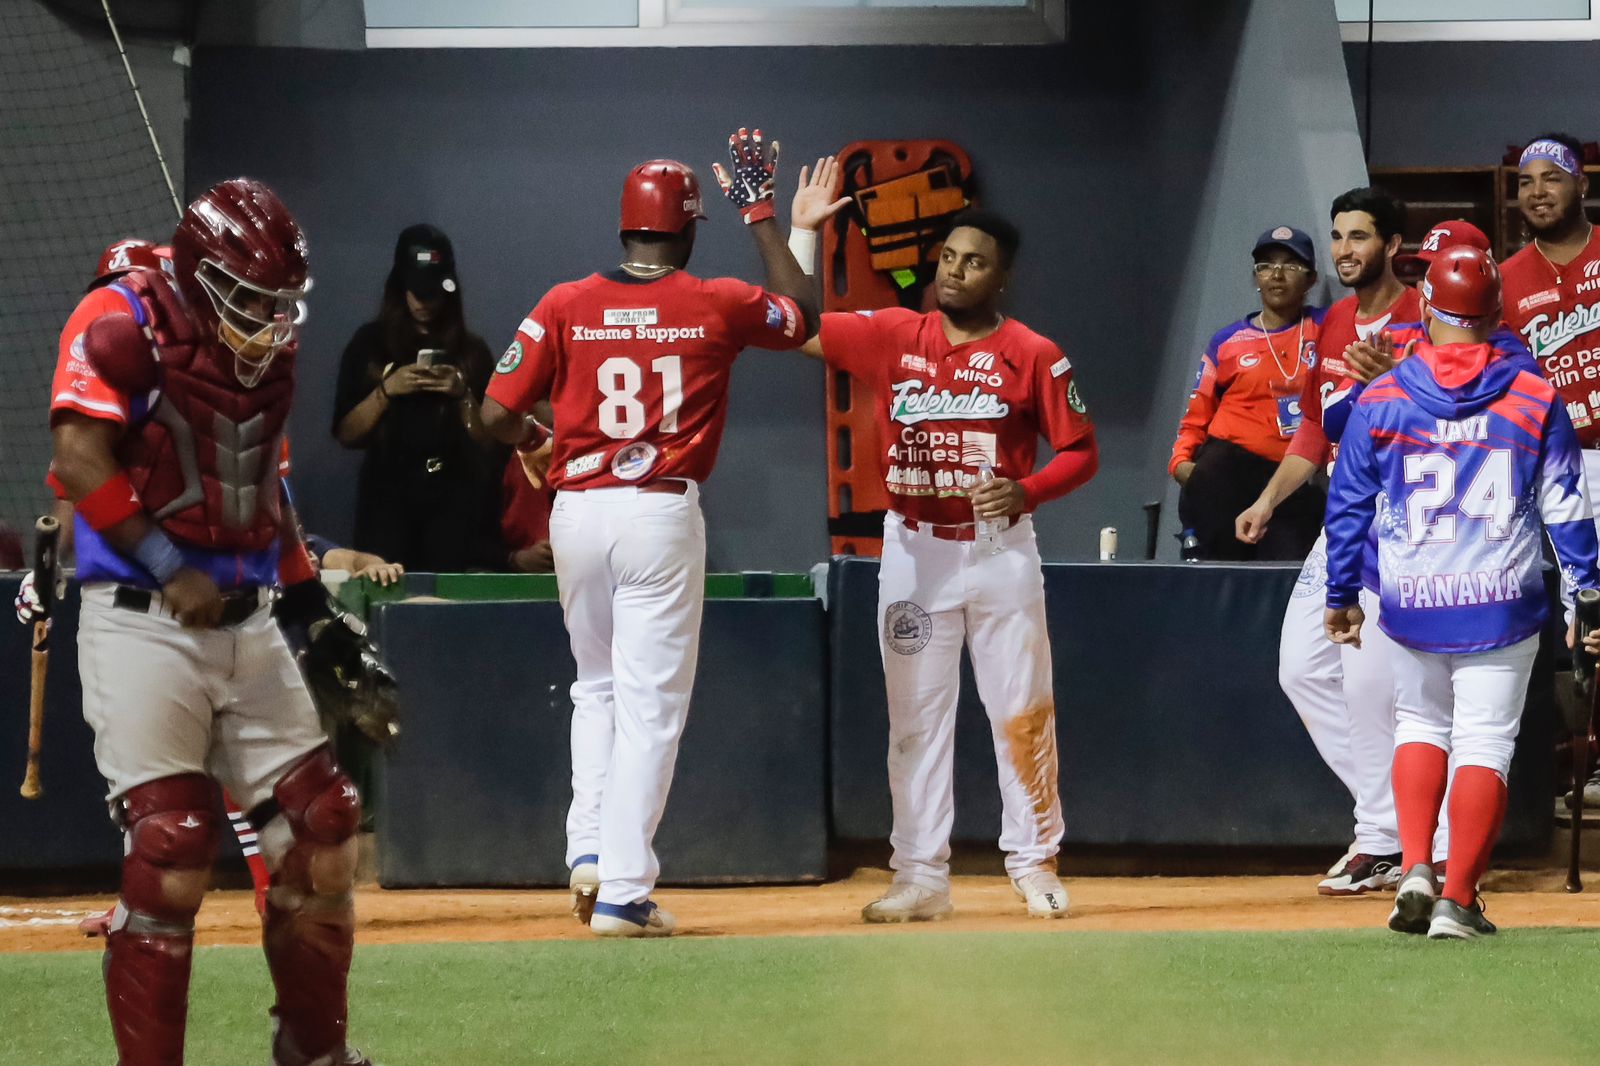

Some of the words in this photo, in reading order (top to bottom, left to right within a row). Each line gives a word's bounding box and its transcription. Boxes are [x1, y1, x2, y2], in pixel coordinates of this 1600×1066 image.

[571, 325, 633, 341] Xtreme
[635, 325, 705, 343] Support
[614, 316, 647, 324] SPORTS
[953, 368, 1004, 388] MIRÓ
[596, 355, 684, 439] 81
[889, 379, 1010, 425] Federales
[901, 426, 960, 448] Copa
[1429, 415, 1489, 444] JAVI
[1403, 448, 1518, 545] 24
[1397, 568, 1523, 609] PANAMA
